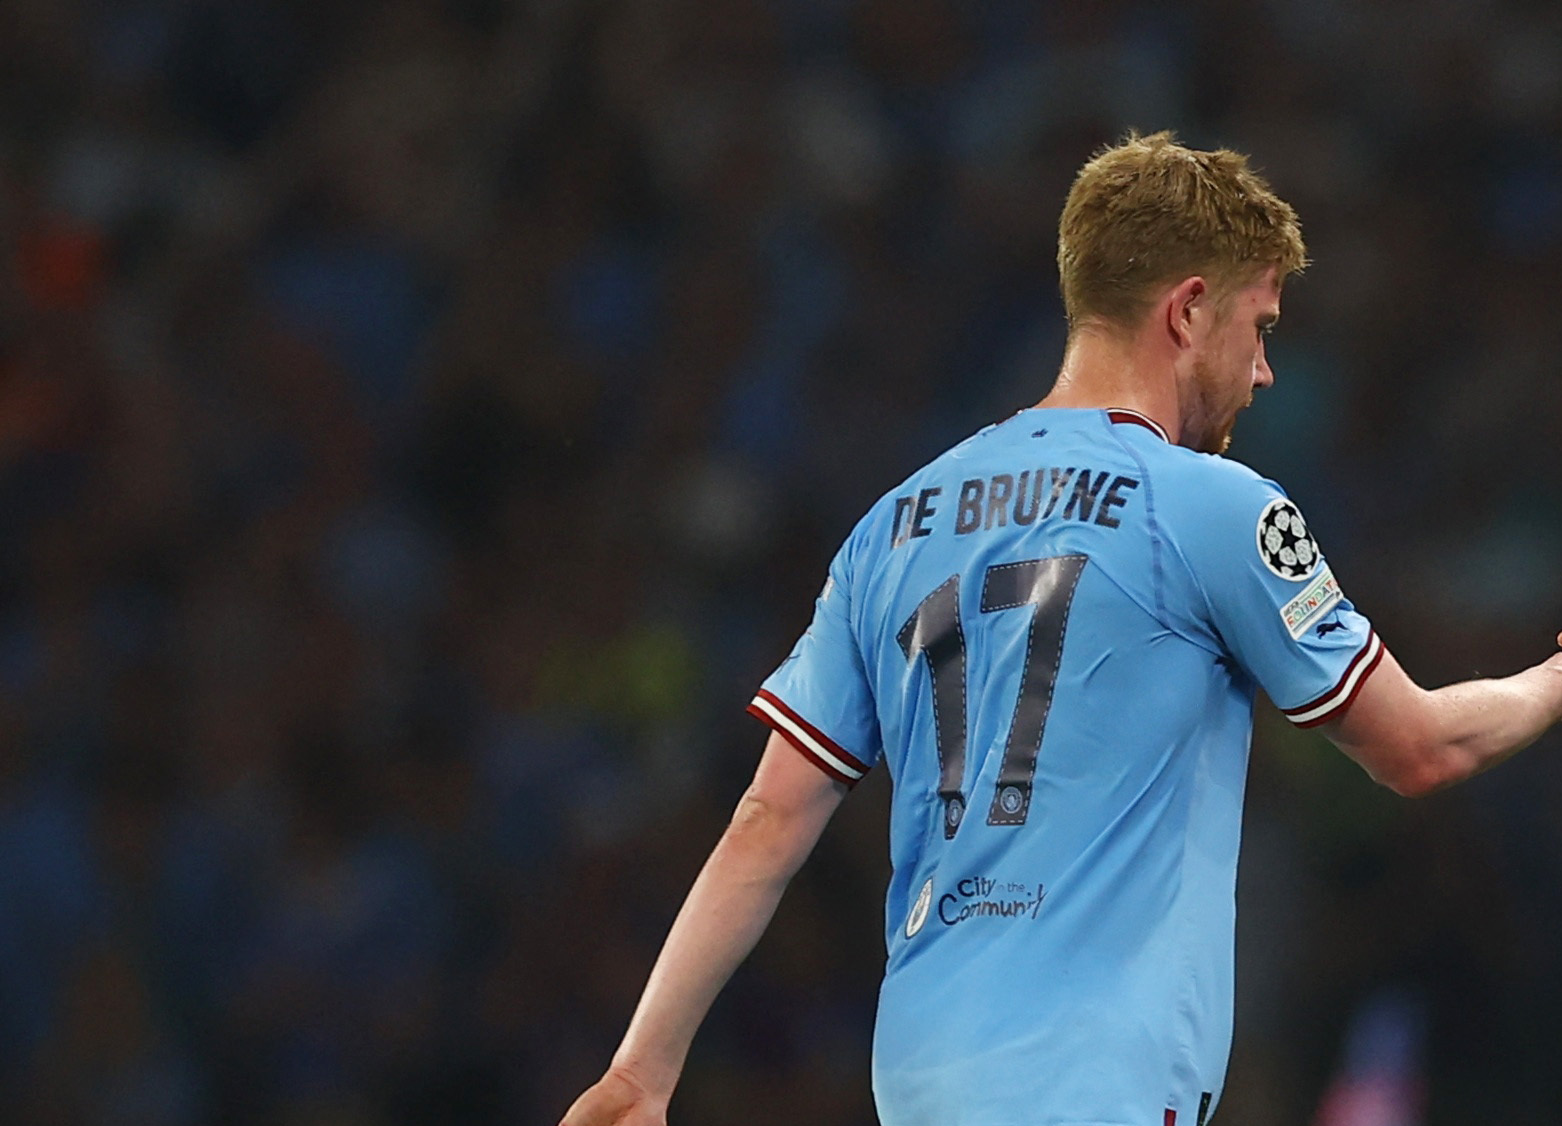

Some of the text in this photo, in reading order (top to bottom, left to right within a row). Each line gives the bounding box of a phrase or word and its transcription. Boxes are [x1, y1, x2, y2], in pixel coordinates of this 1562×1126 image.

[891, 467, 1140, 550] DE BRUYNE
[896, 554, 1090, 841] 17
